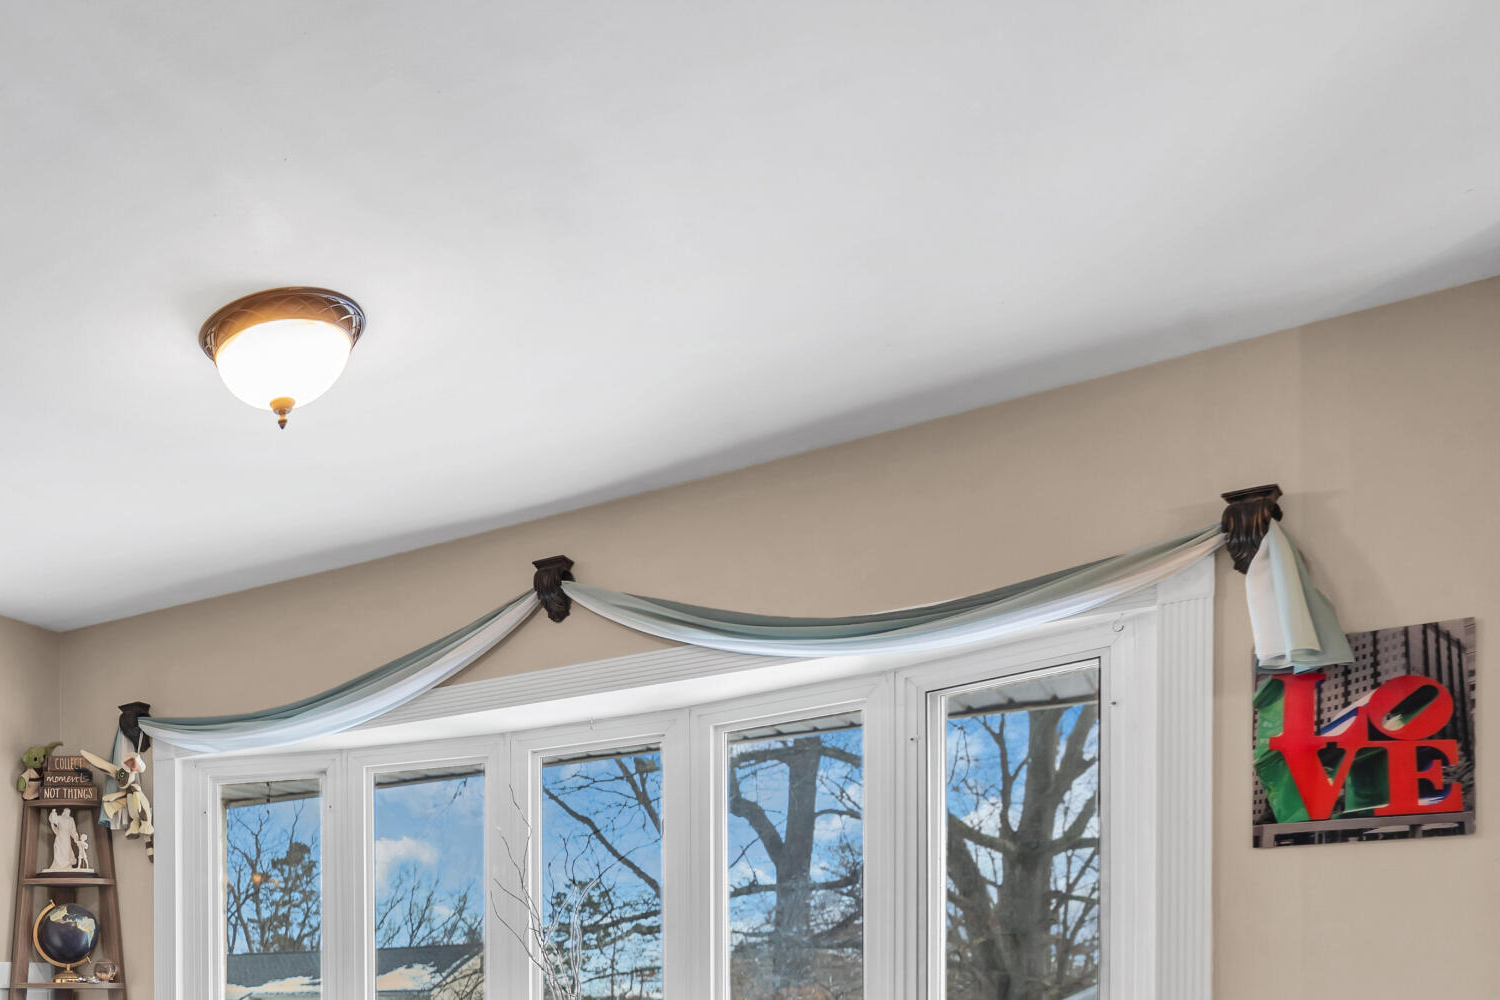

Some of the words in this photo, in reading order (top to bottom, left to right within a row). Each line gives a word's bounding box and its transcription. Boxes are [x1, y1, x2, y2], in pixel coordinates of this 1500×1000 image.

[54, 757, 83, 770] COLLECT
[43, 787, 60, 799] NOT
[63, 787, 93, 800] THINGS
